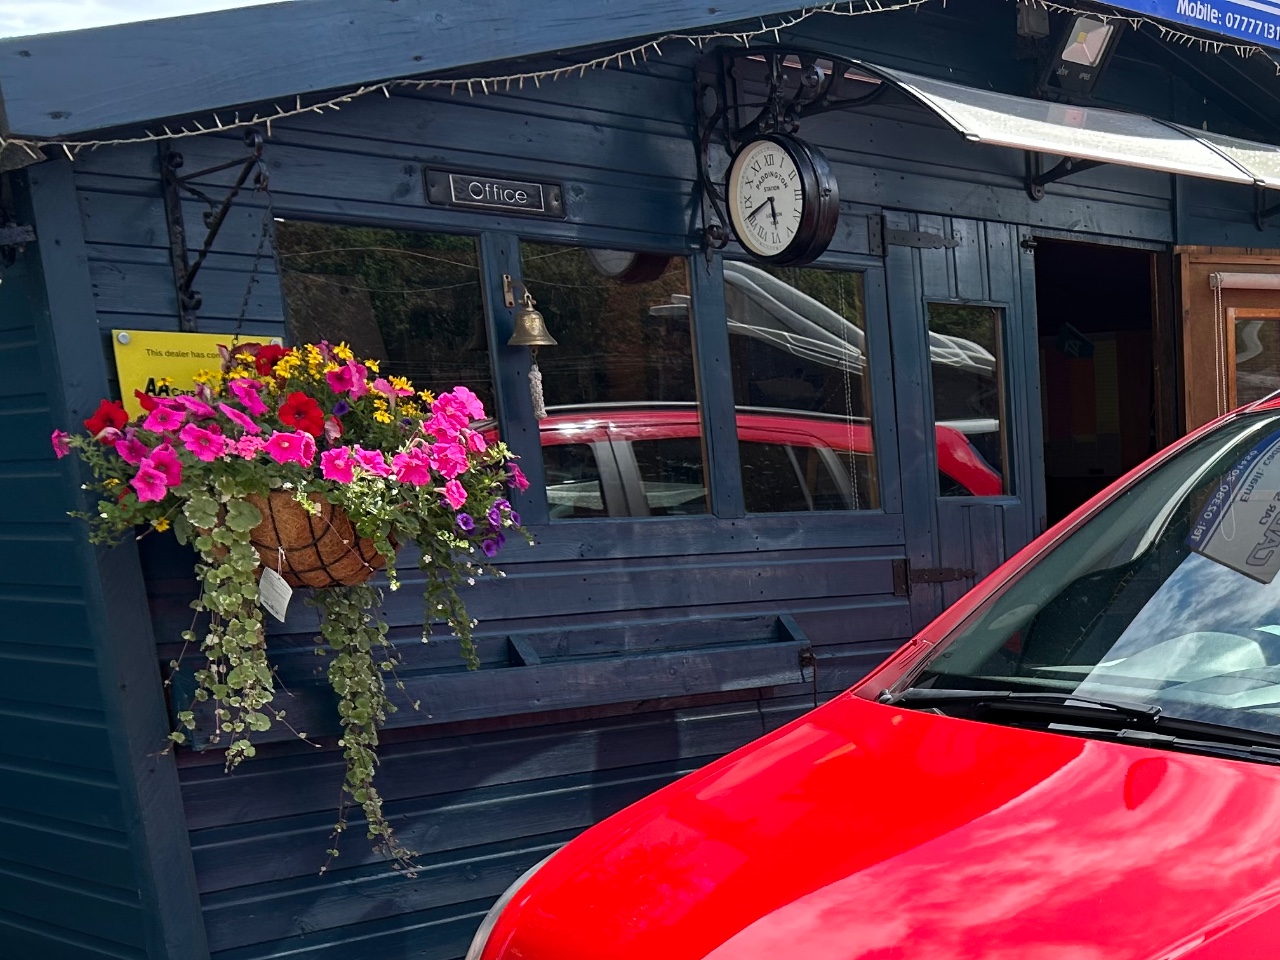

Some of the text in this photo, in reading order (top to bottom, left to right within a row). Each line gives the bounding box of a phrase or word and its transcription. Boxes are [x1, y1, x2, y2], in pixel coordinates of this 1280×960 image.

[1176, 0, 1222, 26] Mobile:
[764, 154, 775, 166] XII
[751, 160, 762, 177] XI
[788, 169, 797, 181] II
[745, 176, 754, 189] X
[755, 171, 789, 190] PADDINGTON
[469, 181, 527, 203] Office
[794, 189, 802, 201] III
[744, 194, 752, 209] IX
[757, 225, 767, 241] VII
[771, 232, 781, 244] VI
[146, 348, 163, 357] This
[164, 350, 189, 358] dealer
[190, 350, 205, 358] has
[145, 377, 196, 398] AA Cars
